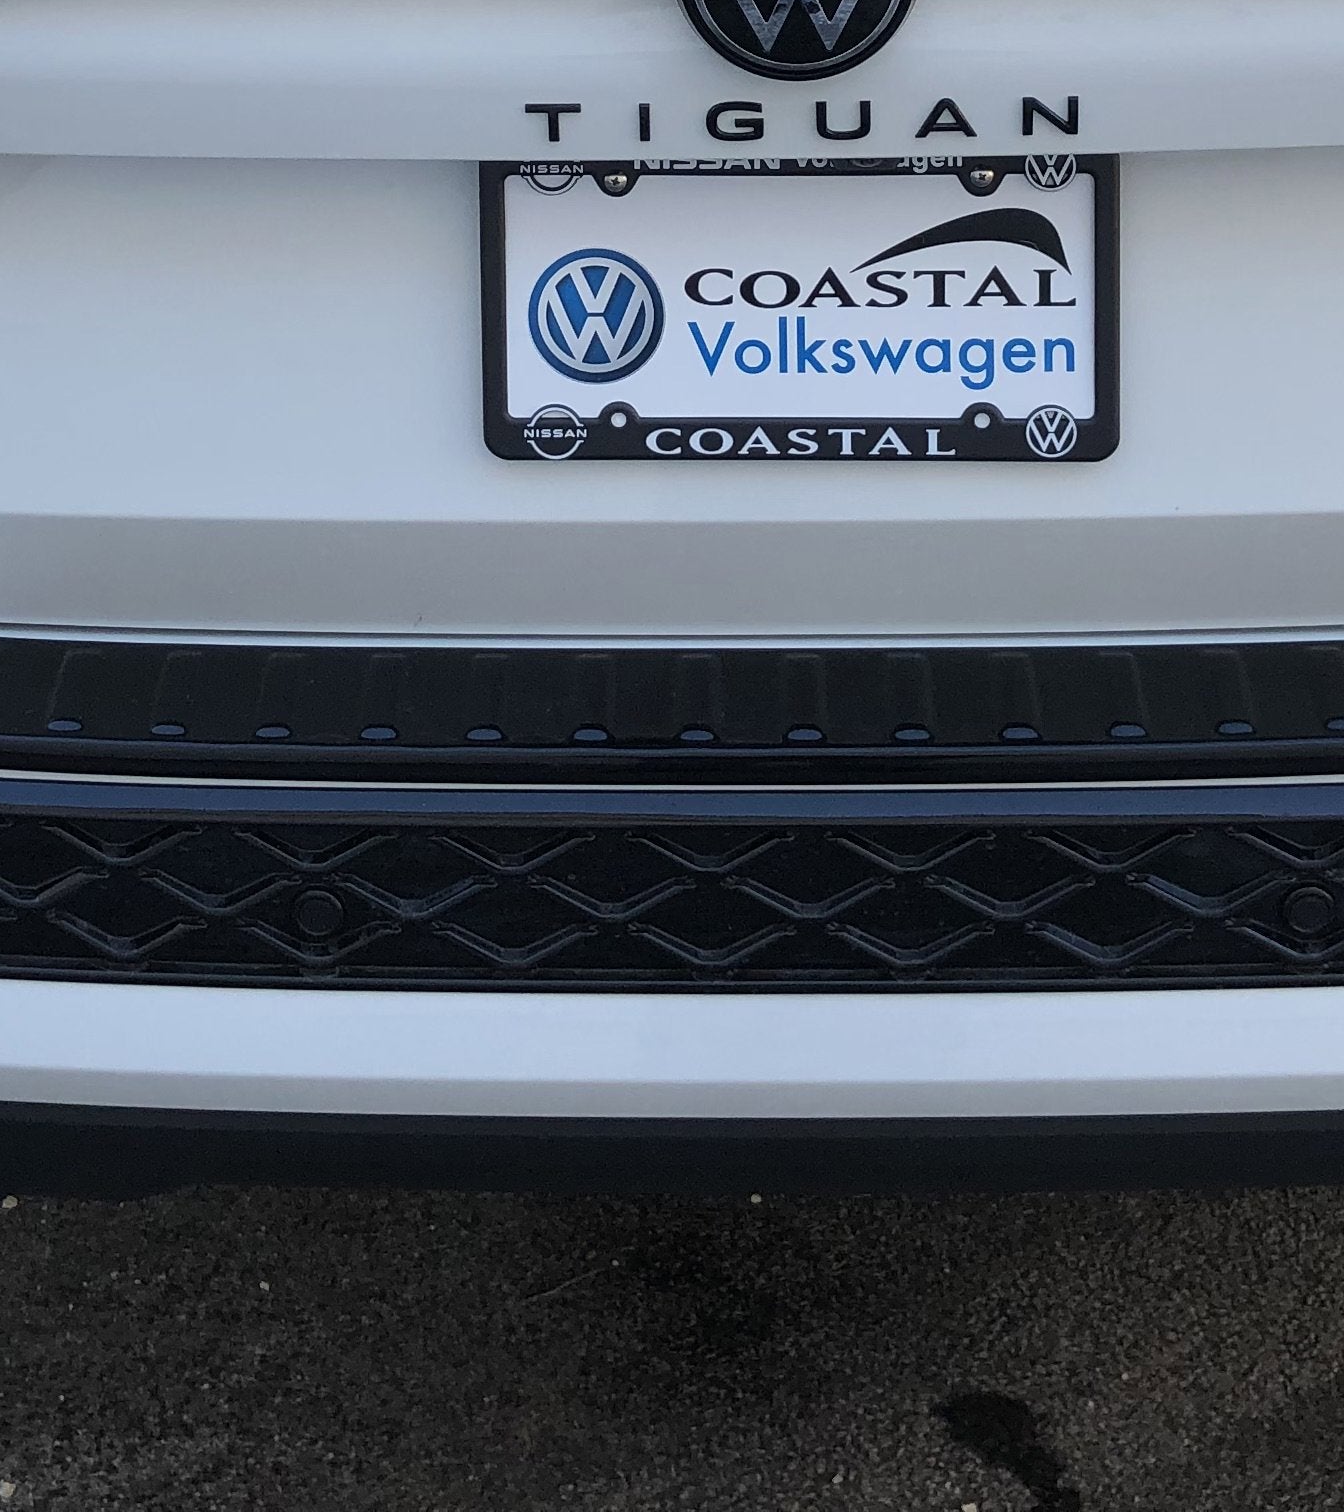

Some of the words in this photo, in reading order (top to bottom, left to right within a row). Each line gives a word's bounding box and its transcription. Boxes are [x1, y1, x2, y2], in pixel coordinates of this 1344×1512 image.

[524, 96, 1080, 142] TIGUAN
[519, 164, 584, 175] NISSAN
[684, 265, 1077, 309] COASTAL
[687, 316, 1076, 390] Volkswagen
[523, 428, 588, 439] NISSAN
[645, 426, 956, 457] COASTAL
